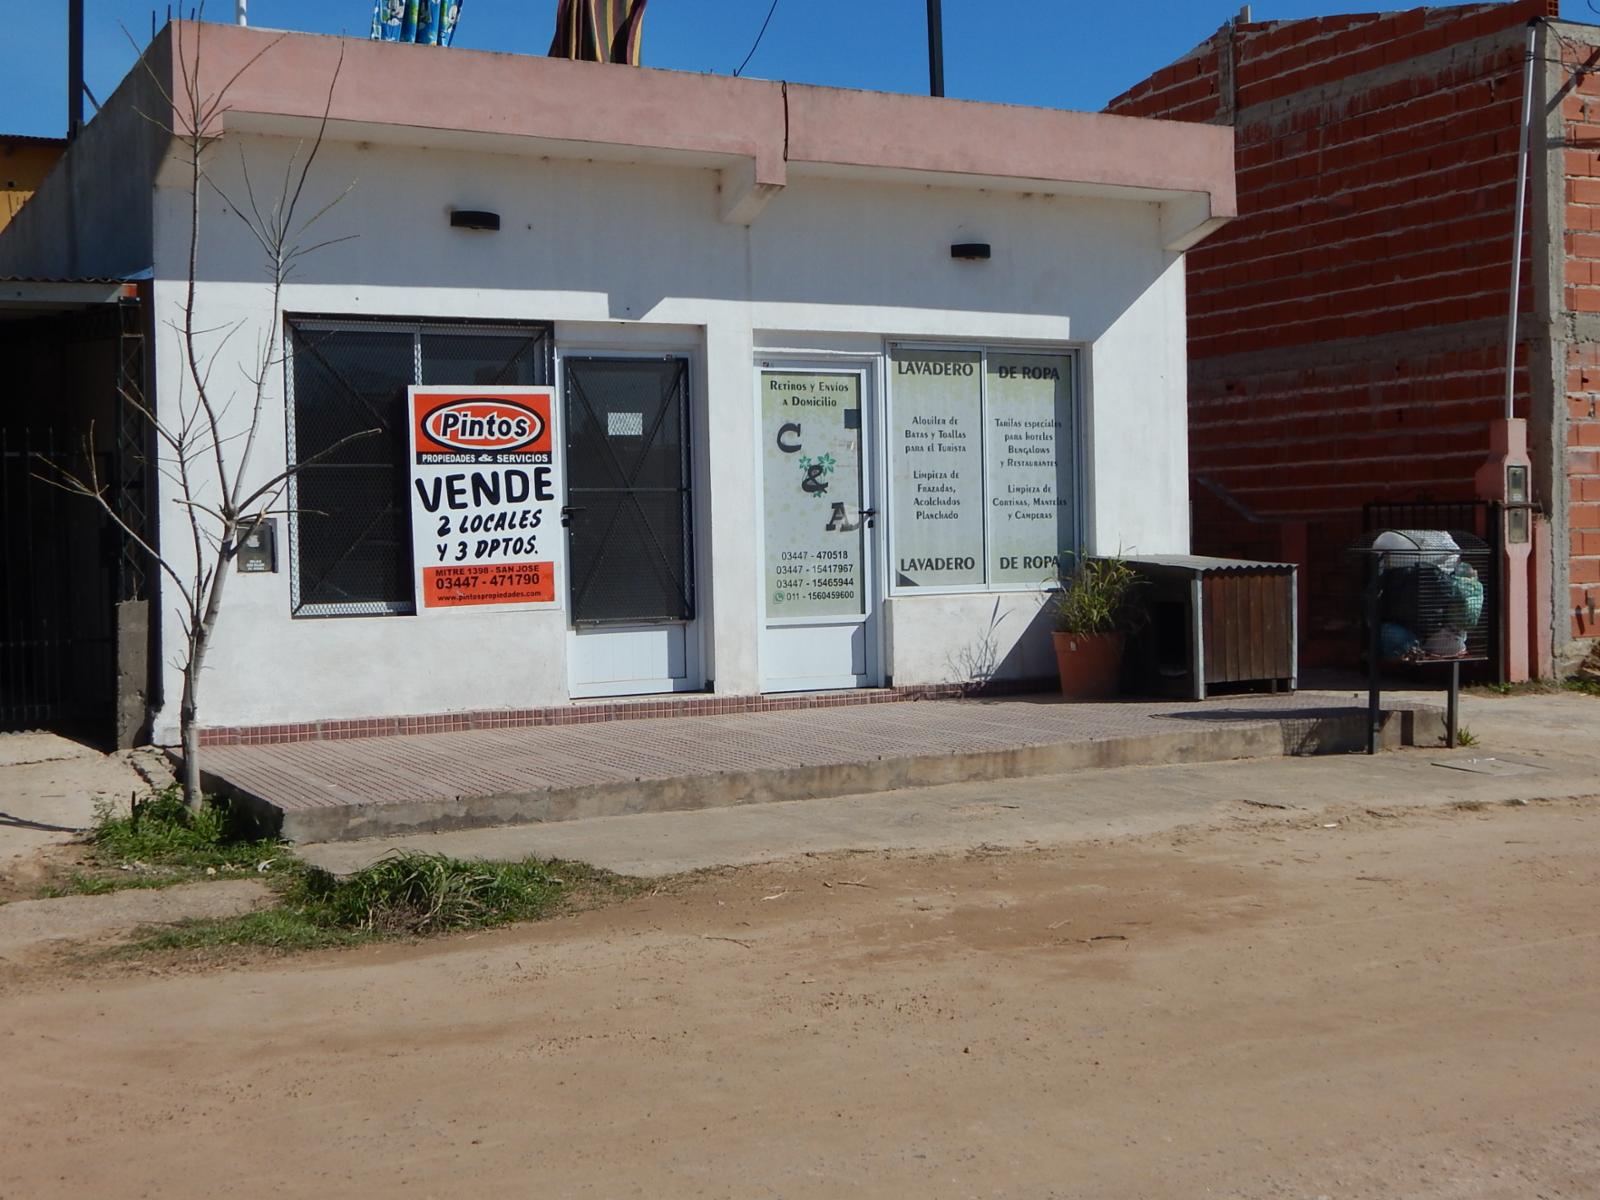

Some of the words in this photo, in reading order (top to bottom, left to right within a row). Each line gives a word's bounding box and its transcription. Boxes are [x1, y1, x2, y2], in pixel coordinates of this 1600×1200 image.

[898, 362, 974, 376] LAVADERO
[999, 366, 1017, 379] DE
[1022, 366, 1060, 380] ROPA
[770, 380, 806, 391] Retiros
[792, 396, 837, 406] Domicilio
[440, 411, 531, 440] Pintos
[949, 416, 958, 426] de
[994, 418, 1022, 428] Tarifas
[1024, 419, 1062, 428] especiales
[905, 430, 928, 438] Batas
[938, 430, 966, 438] Toallas
[1004, 434, 1022, 442] para
[905, 445, 924, 454] para
[928, 443, 934, 452] el
[938, 443, 966, 452] Turista
[422, 454, 476, 463] PROPIEDADES
[478, 454, 493, 462] &
[497, 454, 548, 463] SERVICIOS
[1008, 458, 1058, 466] Restaurantes
[777, 423, 802, 453] C
[802, 465, 828, 493] &
[826, 502, 853, 532] A
[914, 470, 947, 480] Limpieza
[950, 470, 959, 479] de
[415, 467, 554, 512] VENDE
[1008, 484, 1040, 494] Limpieza
[1043, 484, 1051, 493] de
[914, 496, 960, 506] Acolchados
[916, 510, 958, 520] Planchado
[1015, 510, 1052, 520] Camperas
[437, 516, 451, 537] 2
[459, 509, 542, 534] LOCALES
[455, 541, 467, 561] 3
[475, 535, 538, 559] DPTOS.
[782, 552, 808, 560] 03447
[816, 550, 848, 560] 470518
[901, 556, 975, 572] LAVADERO
[1000, 557, 1018, 570] DE
[1024, 556, 1060, 569] ROPA
[436, 568, 464, 576] MITRE
[496, 566, 514, 574] SAN
[516, 565, 540, 573] JOSE
[776, 566, 803, 574] 03447
[436, 576, 479, 590] 03447
[490, 573, 540, 586] 471790
[776, 580, 804, 588] 03447
[812, 578, 854, 588] 15465944
[438, 591, 541, 602] www.pintospropiedades.com
[786, 592, 800, 600] 011
